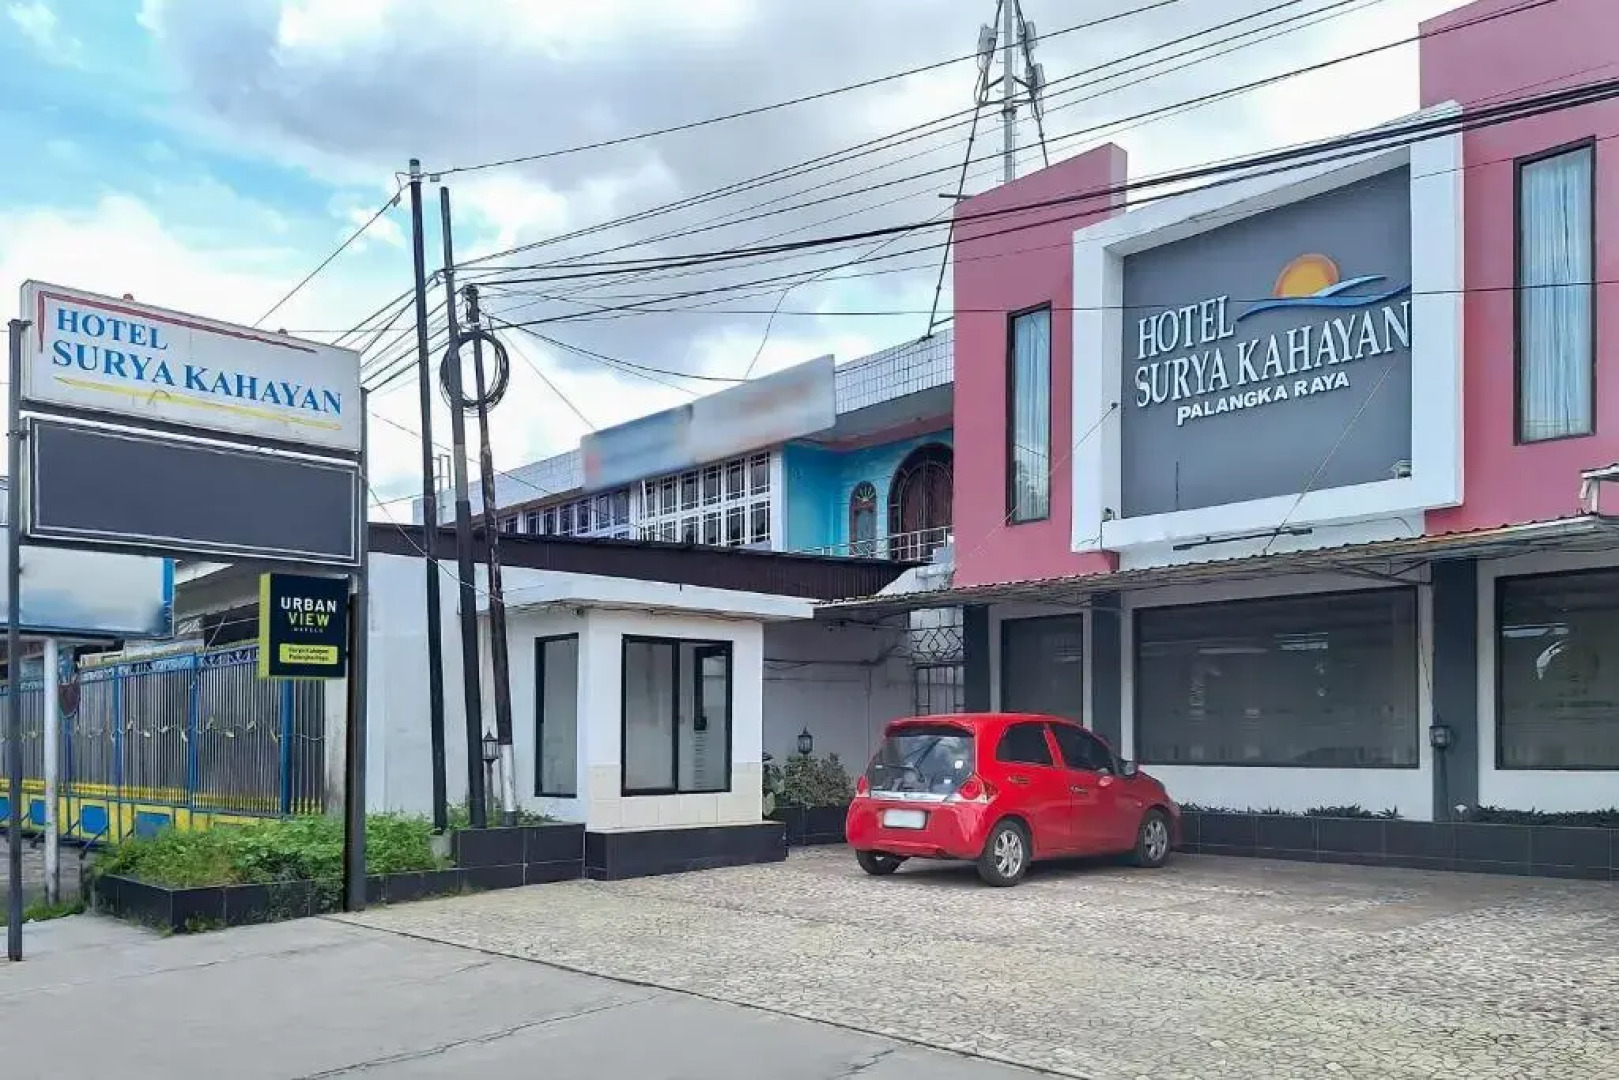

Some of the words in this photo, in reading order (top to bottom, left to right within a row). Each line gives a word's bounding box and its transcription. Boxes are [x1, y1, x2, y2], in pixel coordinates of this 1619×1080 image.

[57, 308, 168, 350] HOTEL
[1135, 347, 1229, 408] SURYA
[1237, 301, 1411, 385] KAHAYAN
[1138, 295, 1234, 360] HOTEL
[52, 339, 175, 386] SURYA
[184, 365, 342, 414] KAHAYAN
[1176, 385, 1288, 426] PALANGKA
[1294, 371, 1350, 397] RAYA
[281, 597, 337, 613] URBAN
[288, 611, 330, 627] VIEW
